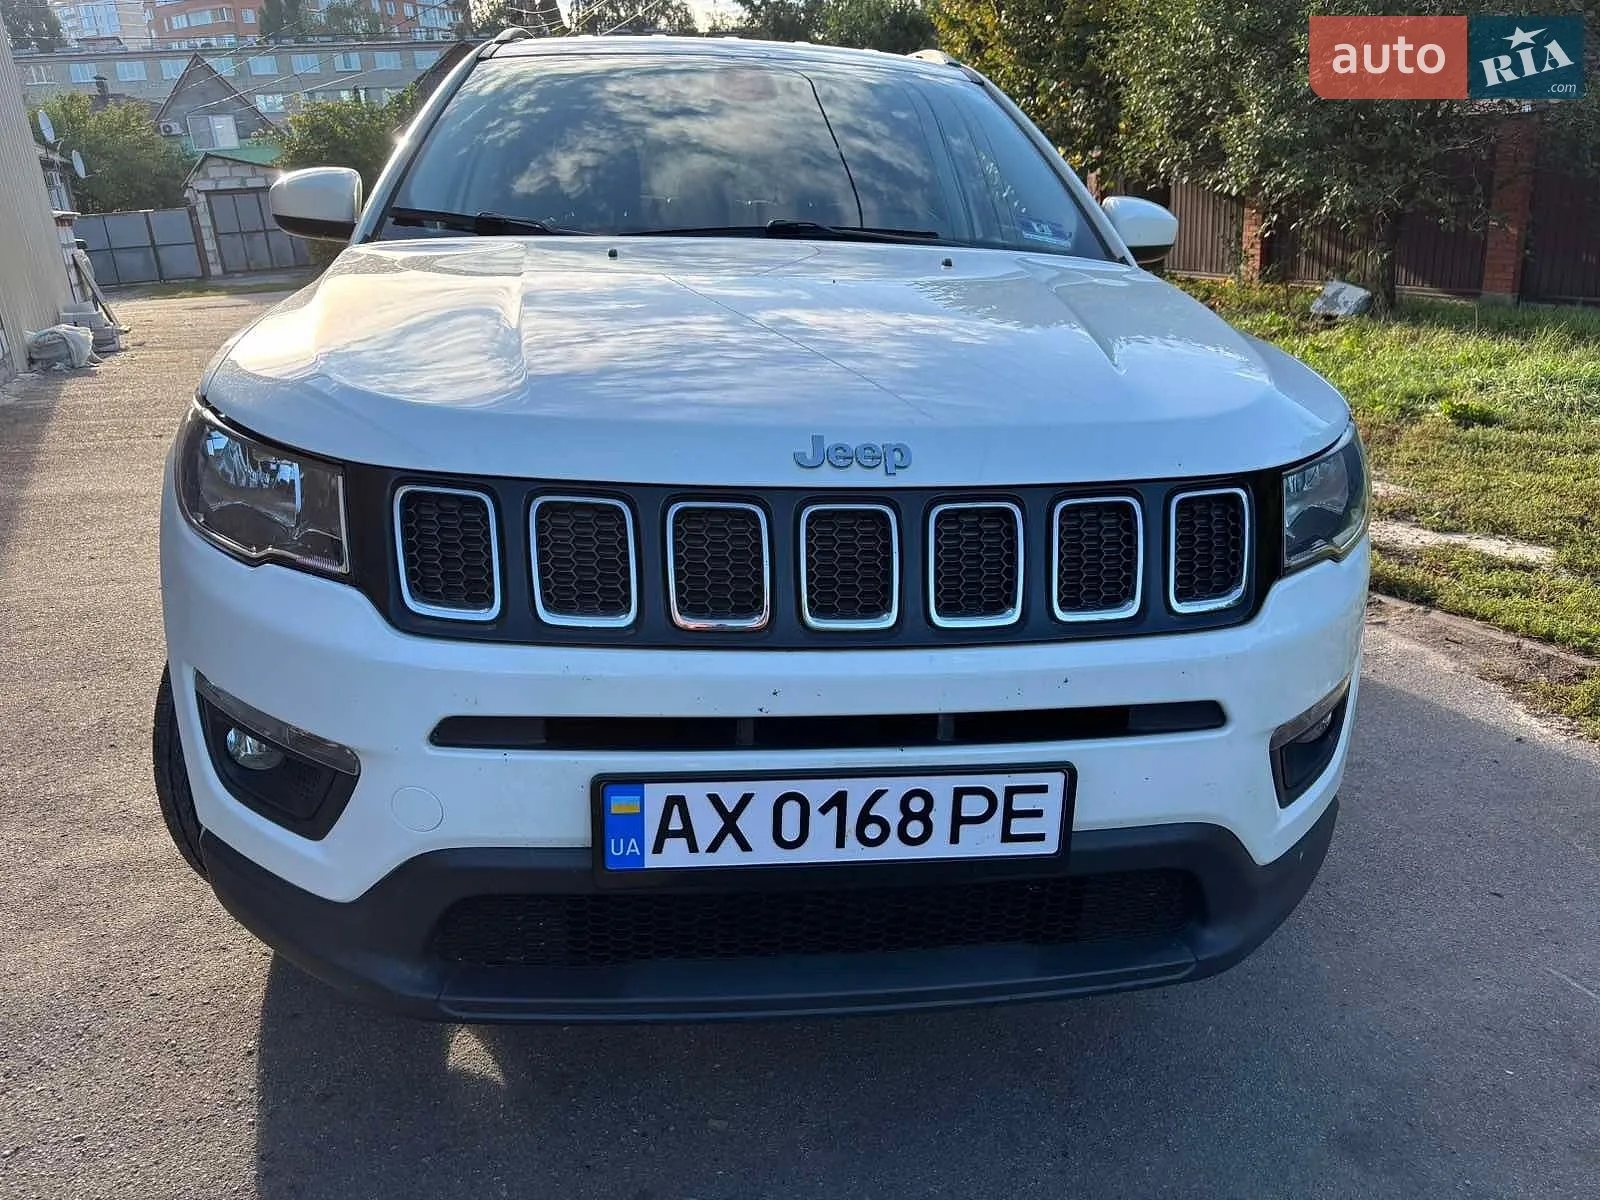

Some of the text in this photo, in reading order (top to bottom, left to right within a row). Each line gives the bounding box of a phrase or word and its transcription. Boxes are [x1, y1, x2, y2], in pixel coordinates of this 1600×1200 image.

[793, 434, 912, 476] Jeep
[651, 783, 1050, 855] AX 0168 PE
[610, 837, 641, 857] UA
